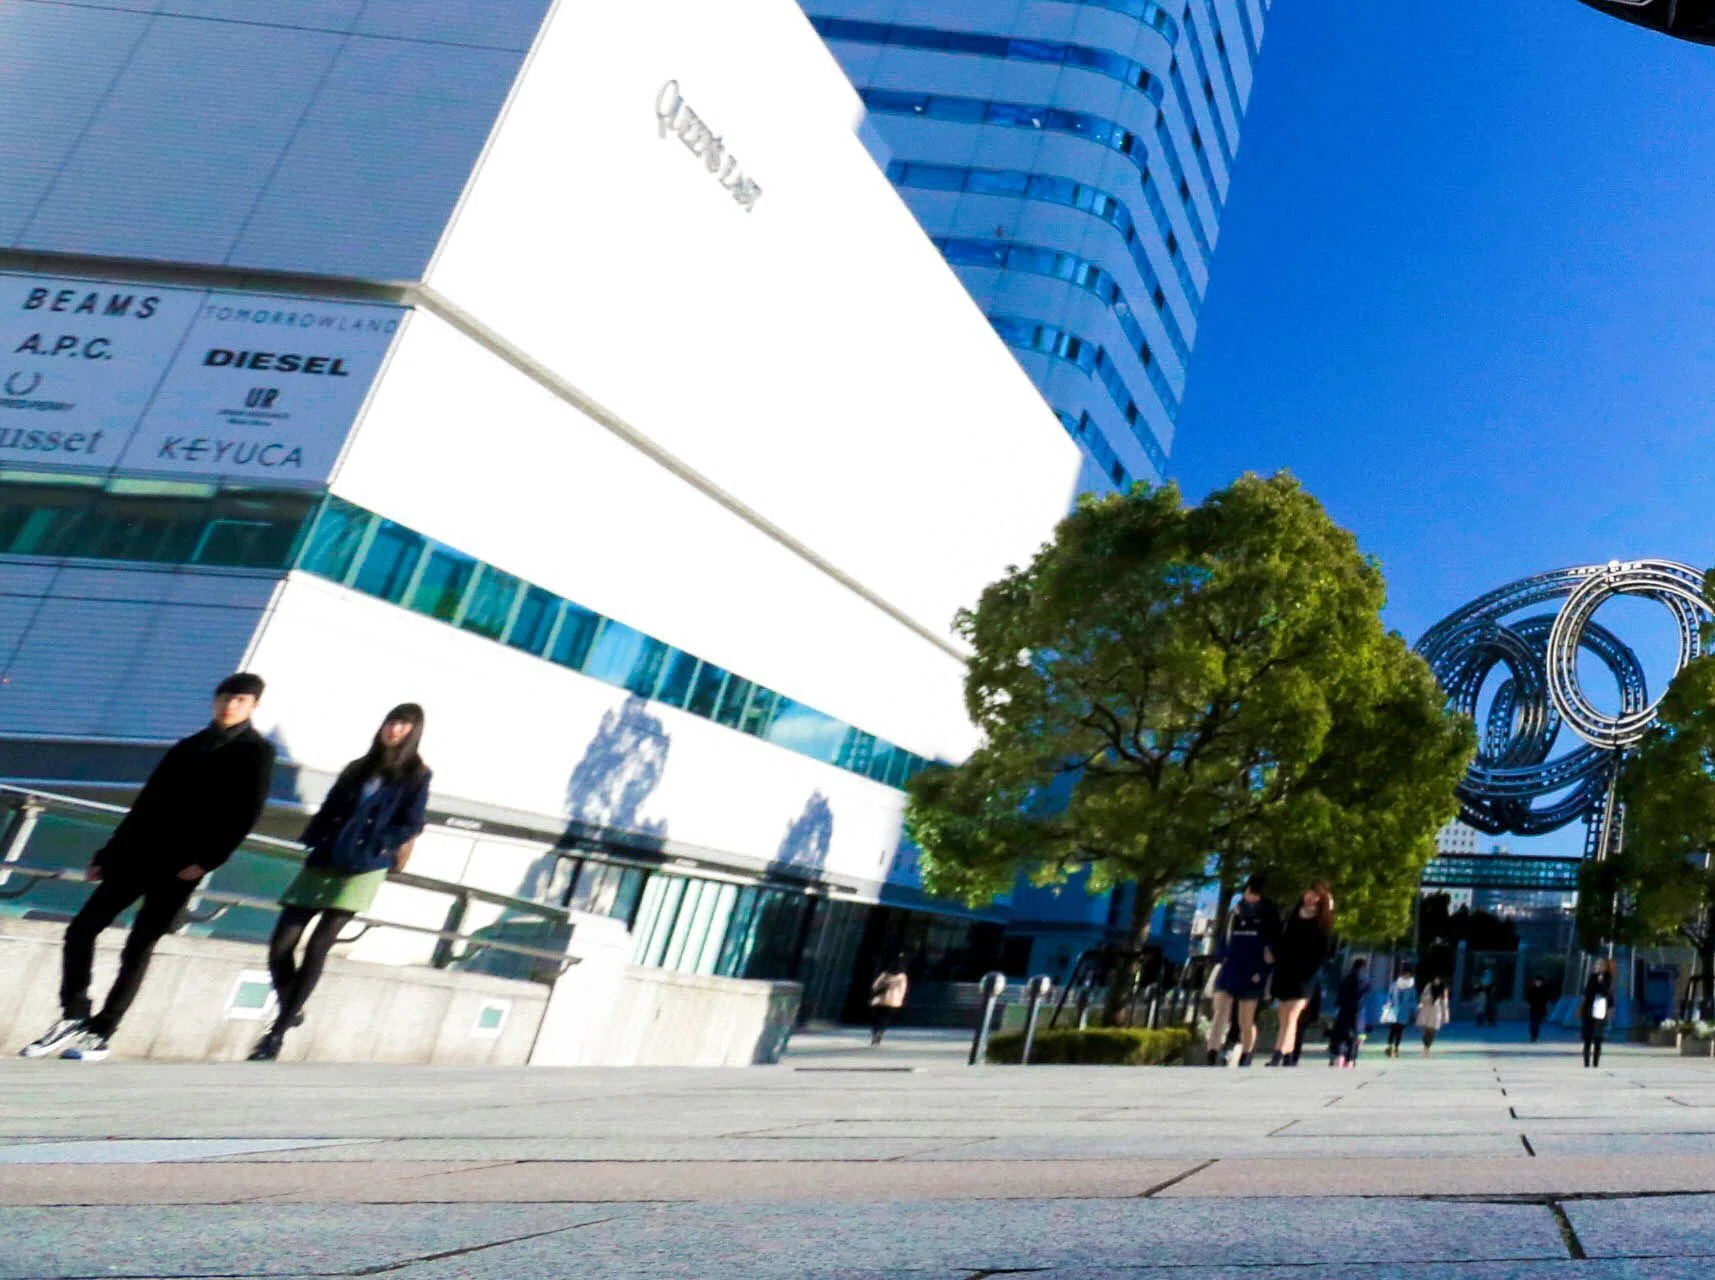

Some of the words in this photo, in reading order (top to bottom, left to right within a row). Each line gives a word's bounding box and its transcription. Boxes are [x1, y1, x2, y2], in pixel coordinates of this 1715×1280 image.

[23, 287, 162, 320] BEAMS
[202, 305, 398, 334] TOMORROWLAND
[15, 333, 114, 361] A.P.C.
[202, 348, 350, 377] DIESEL
[244, 386, 281, 409] UR
[156, 435, 304, 468] KEYUCA
